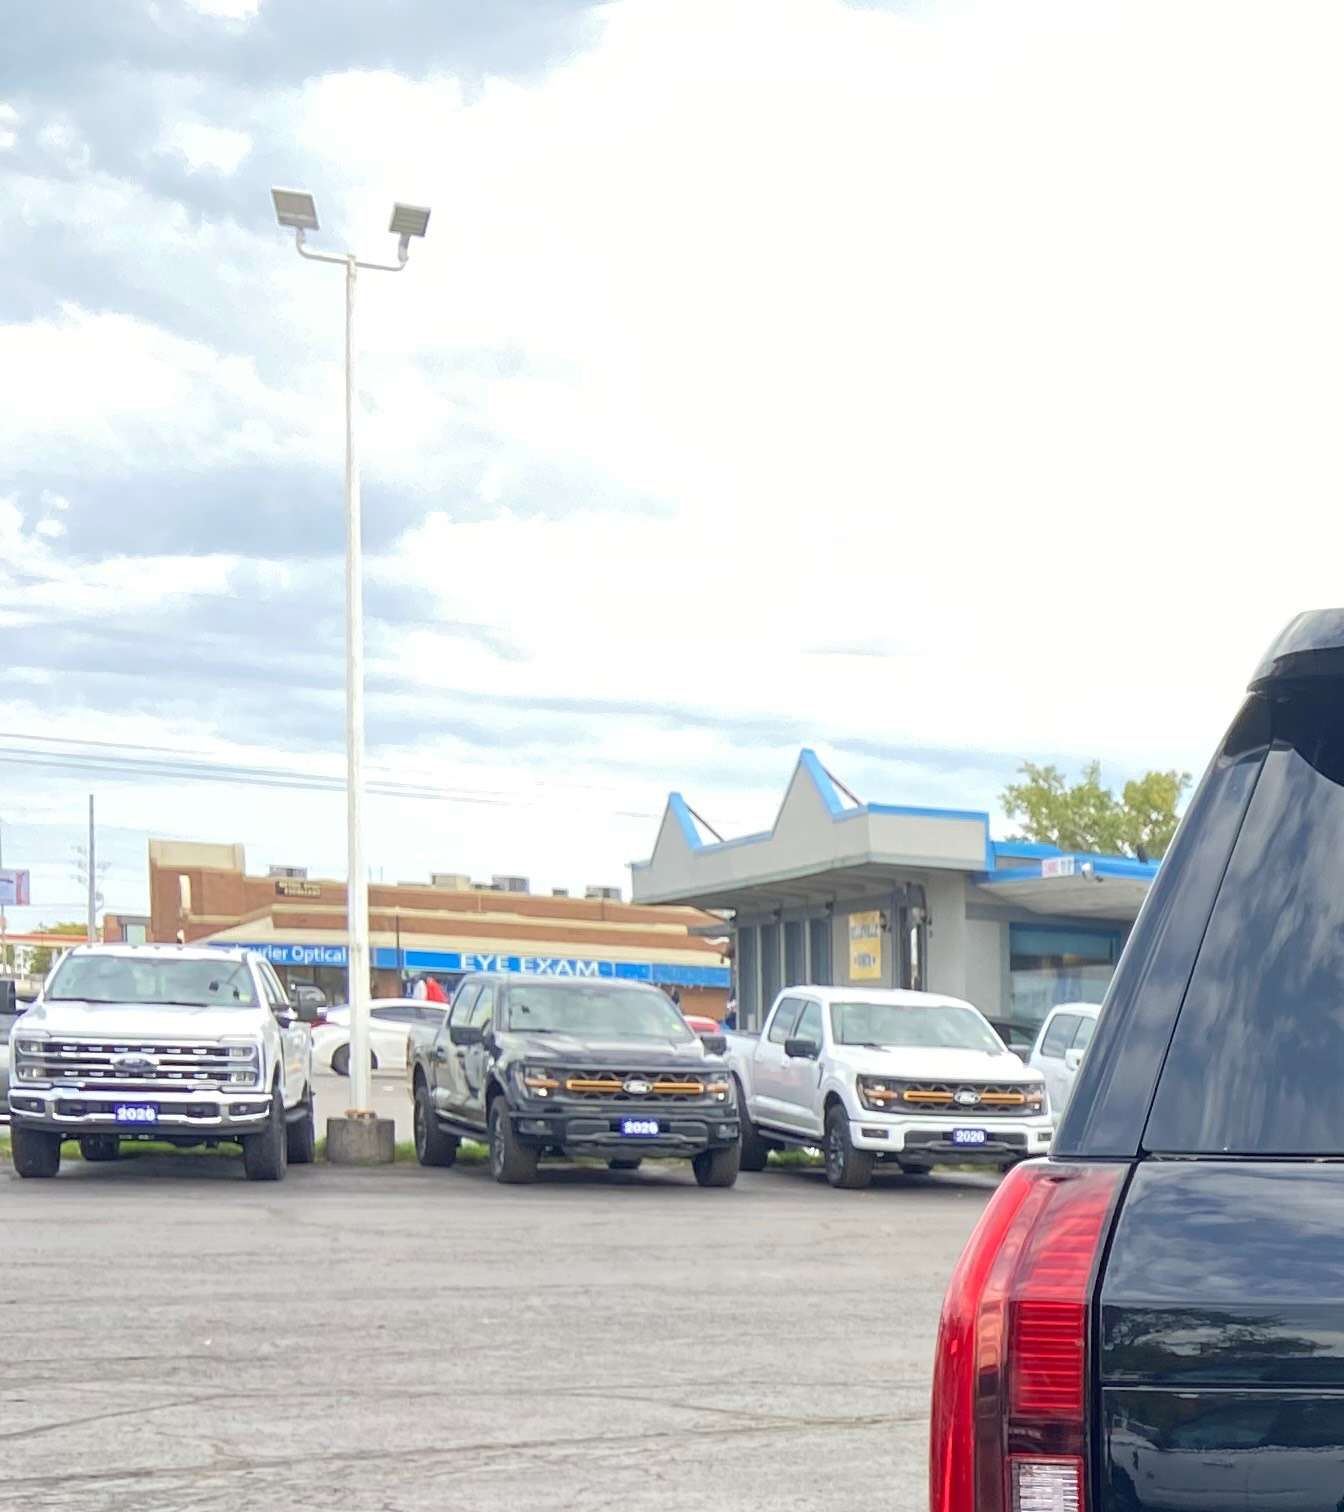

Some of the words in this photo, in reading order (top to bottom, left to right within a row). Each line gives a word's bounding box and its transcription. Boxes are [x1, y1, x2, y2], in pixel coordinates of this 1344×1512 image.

[291, 945, 347, 964] Optical
[460, 953, 510, 972] EYE
[519, 957, 600, 977] EXAM
[956, 1129, 985, 1143] 2026
